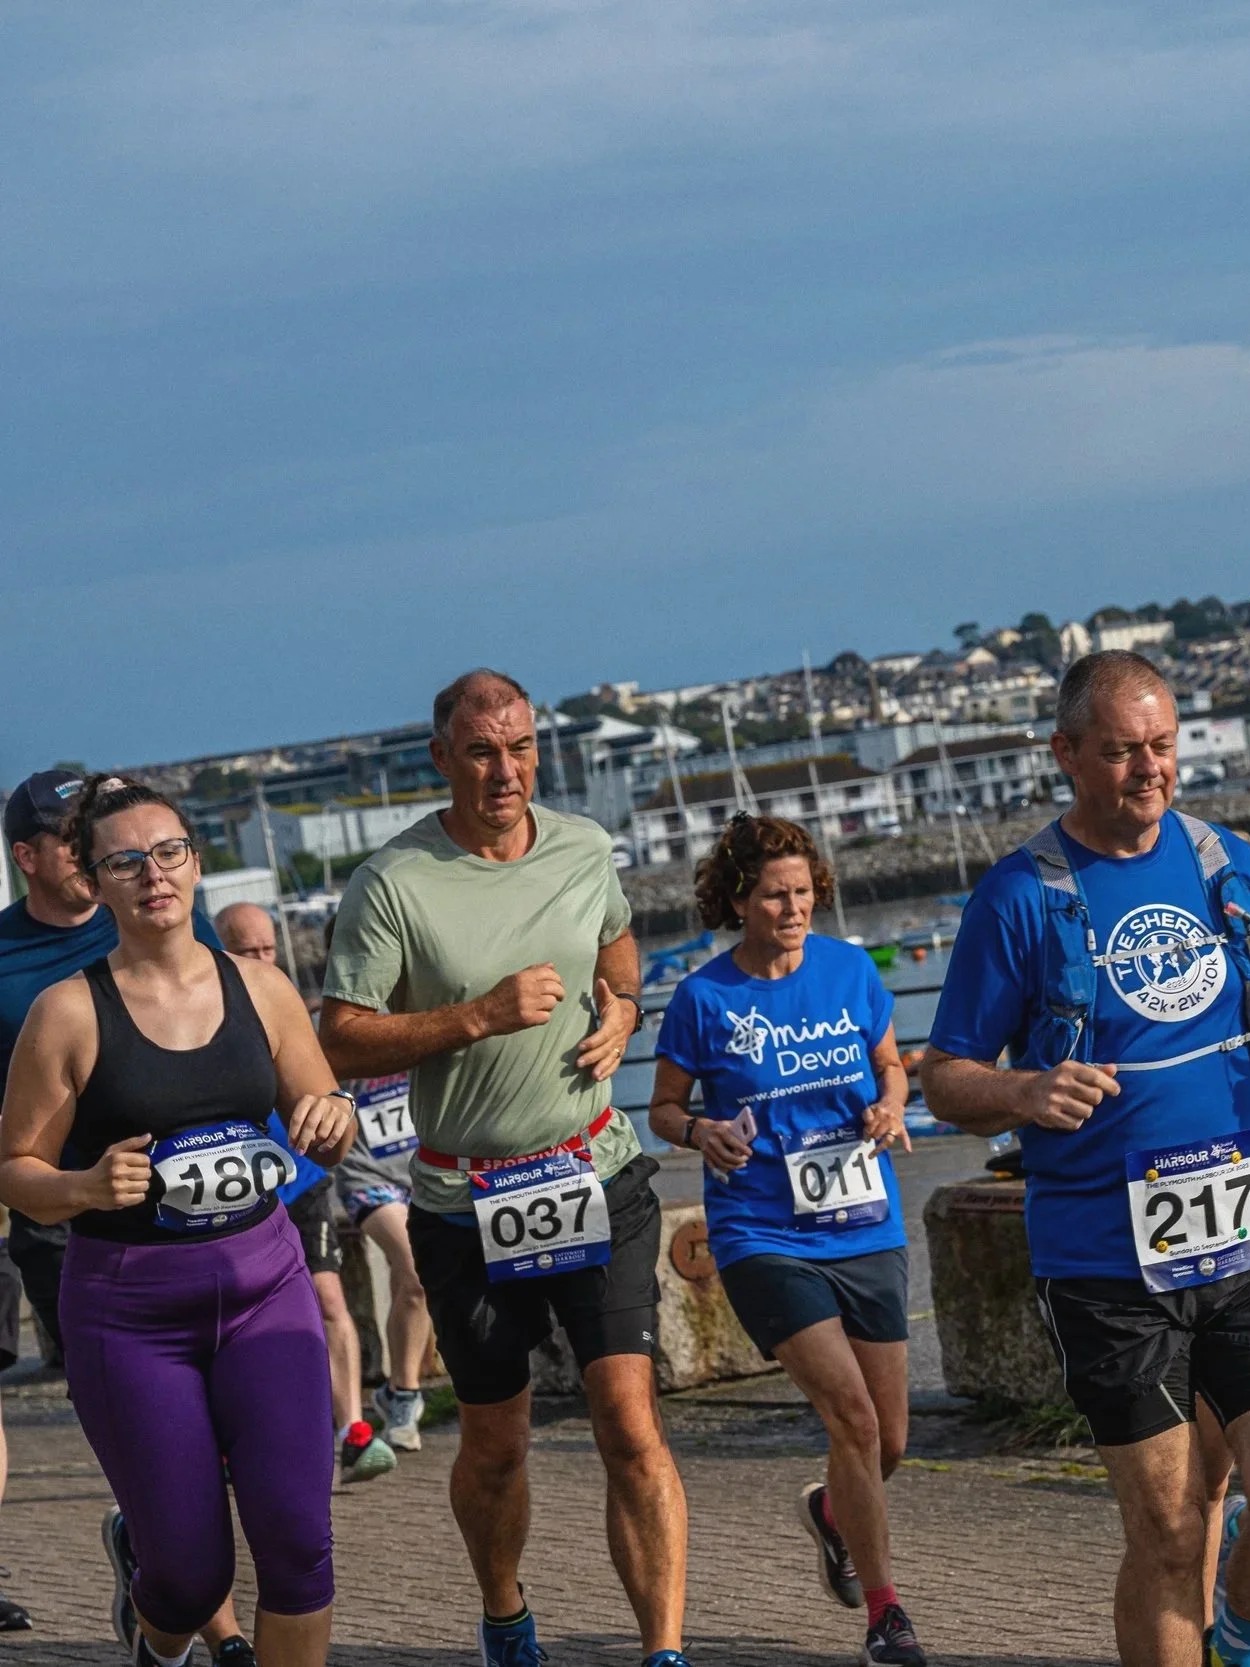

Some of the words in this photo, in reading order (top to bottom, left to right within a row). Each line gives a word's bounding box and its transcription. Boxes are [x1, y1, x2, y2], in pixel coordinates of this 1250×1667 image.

[1166, 977, 1187, 988] 2022
[768, 1008, 860, 1048] mind
[776, 1043, 861, 1077] Devon
[736, 1071, 864, 1104] www.devonmind.com
[371, 1106, 404, 1136] 17
[172, 1132, 225, 1149] HARBOUR
[185, 1151, 217, 1160] PLYMOUTH
[1154, 1150, 1209, 1170] HARBOUR
[179, 1151, 287, 1206] 180
[494, 1168, 543, 1188] HARBOUR
[555, 1169, 573, 1177] Devon
[799, 1153, 872, 1203] 011
[1160, 1176, 1196, 1188] PLYMOUTH
[1196, 1169, 1226, 1180] HARBOUR
[501, 1191, 533, 1203] PLYMOUTH
[533, 1184, 560, 1195] HARBOUR
[490, 1187, 592, 1248] 037
[1169, 1248, 1192, 1257] Sunday
[1201, 1240, 1229, 1250] September
